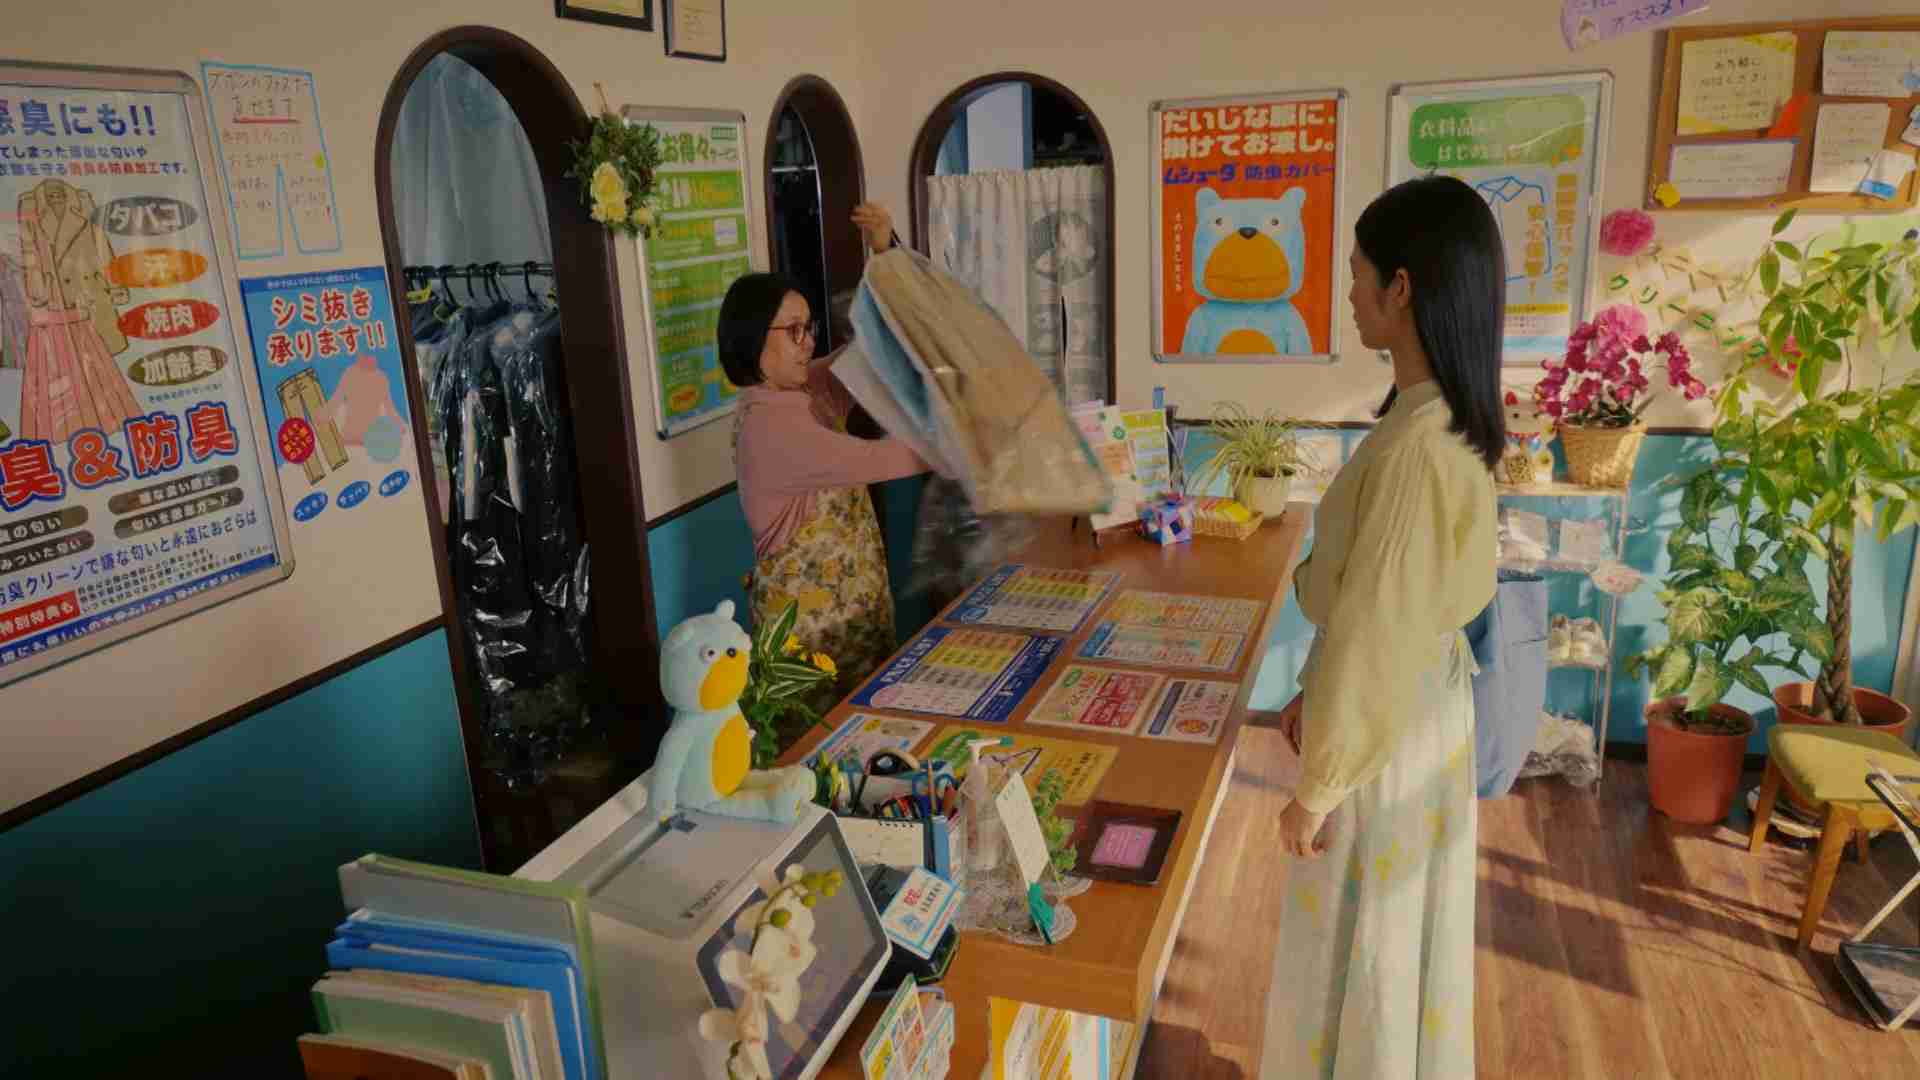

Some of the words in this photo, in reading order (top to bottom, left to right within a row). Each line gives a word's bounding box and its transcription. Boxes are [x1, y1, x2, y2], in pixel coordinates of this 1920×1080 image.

[108, 206, 186, 236] タバコ
[144, 303, 196, 332] 焼肉
[271, 287, 371, 329] シミ抜き
[267, 318, 387, 366] 承ります!!
